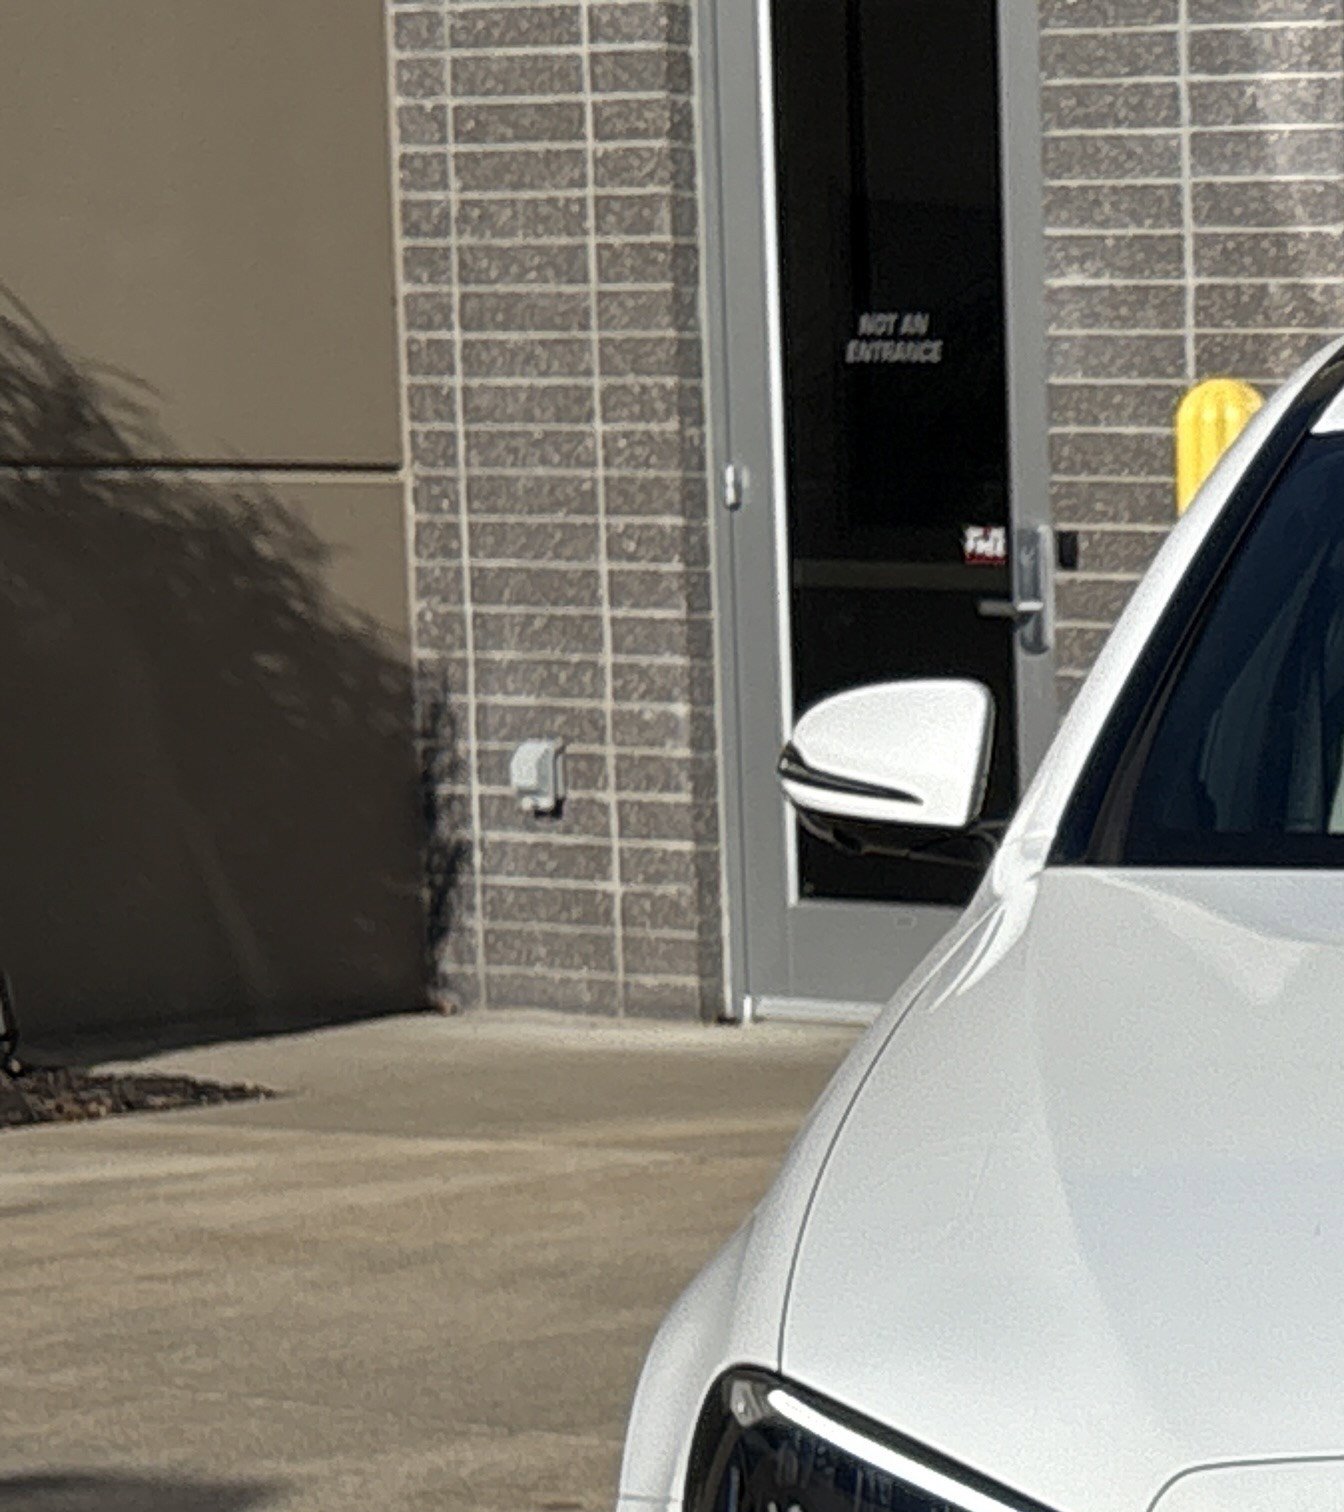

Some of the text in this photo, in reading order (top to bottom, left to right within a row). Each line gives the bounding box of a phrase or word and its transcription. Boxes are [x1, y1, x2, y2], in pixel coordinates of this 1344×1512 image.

[858, 312, 930, 336] NOT AN
[845, 339, 943, 363] ENTRANCE
